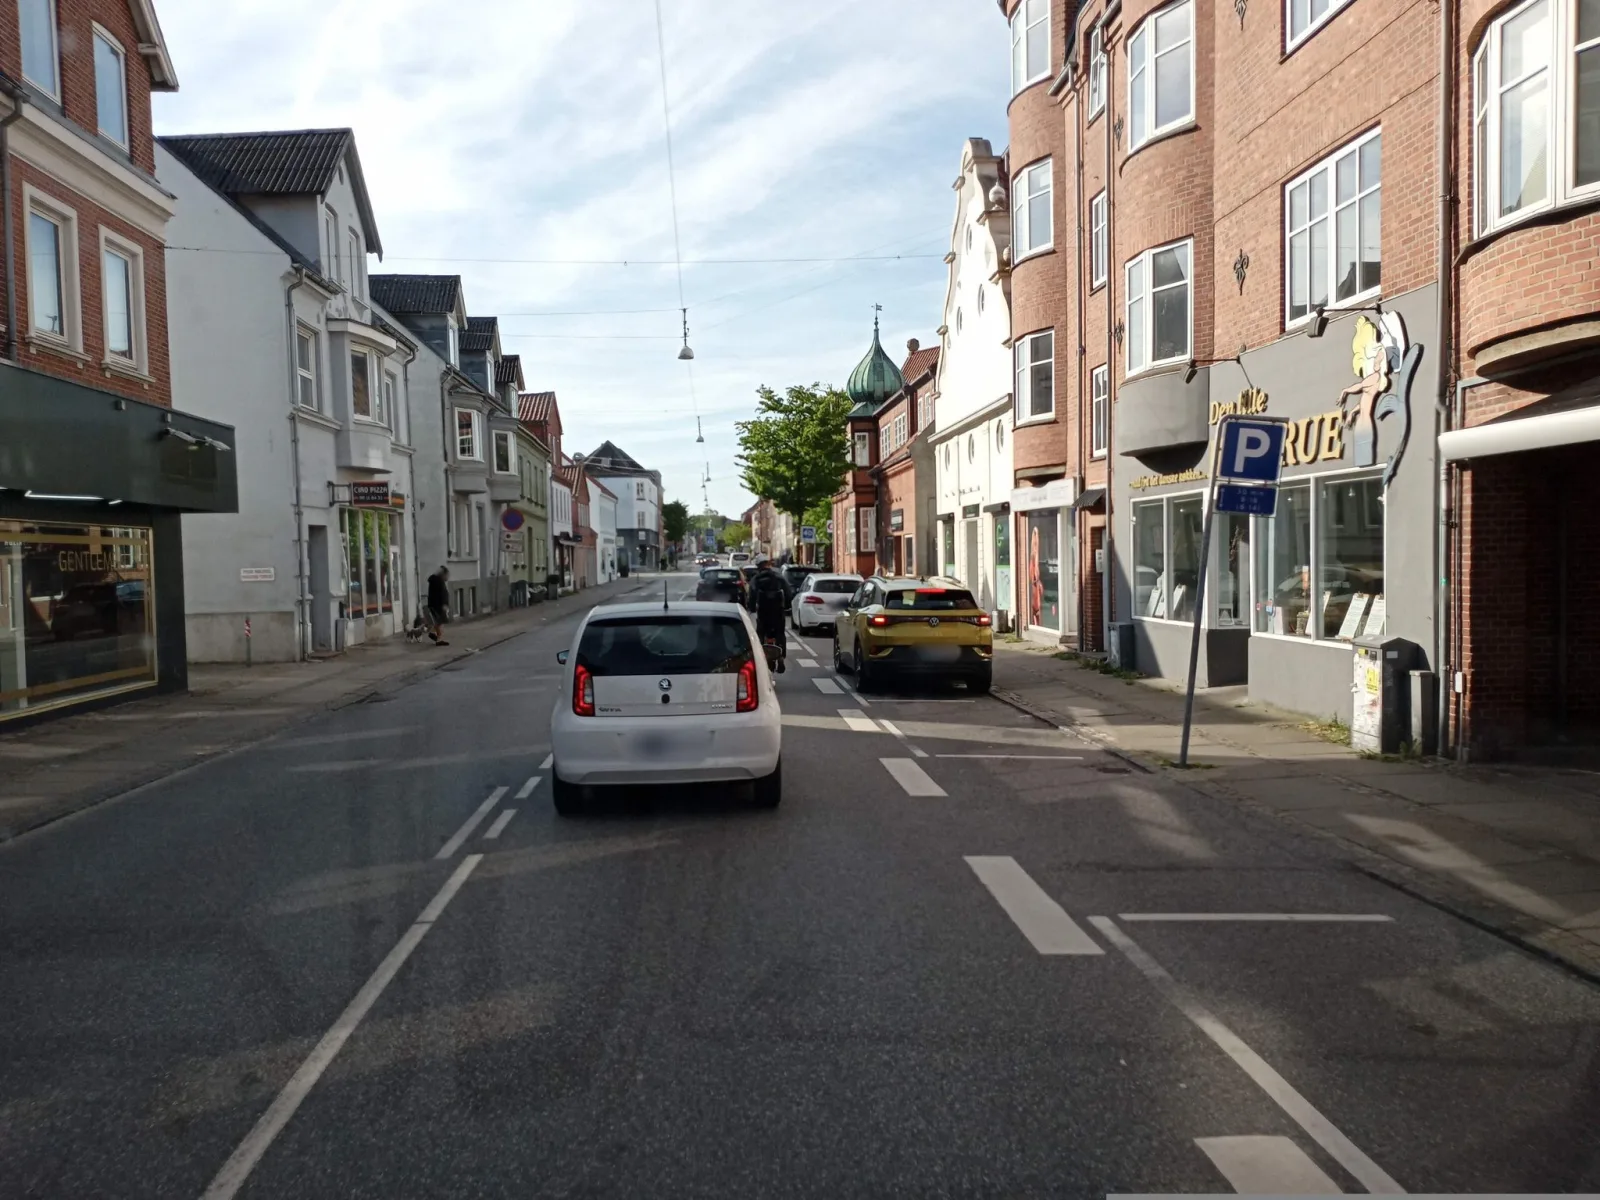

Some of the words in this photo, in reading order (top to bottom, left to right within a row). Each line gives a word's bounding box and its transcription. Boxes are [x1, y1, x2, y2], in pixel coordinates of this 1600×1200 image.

[1234, 428, 1271, 473] P
[1282, 409, 1345, 466] RUE
[370, 486, 388, 494] PIZZA
